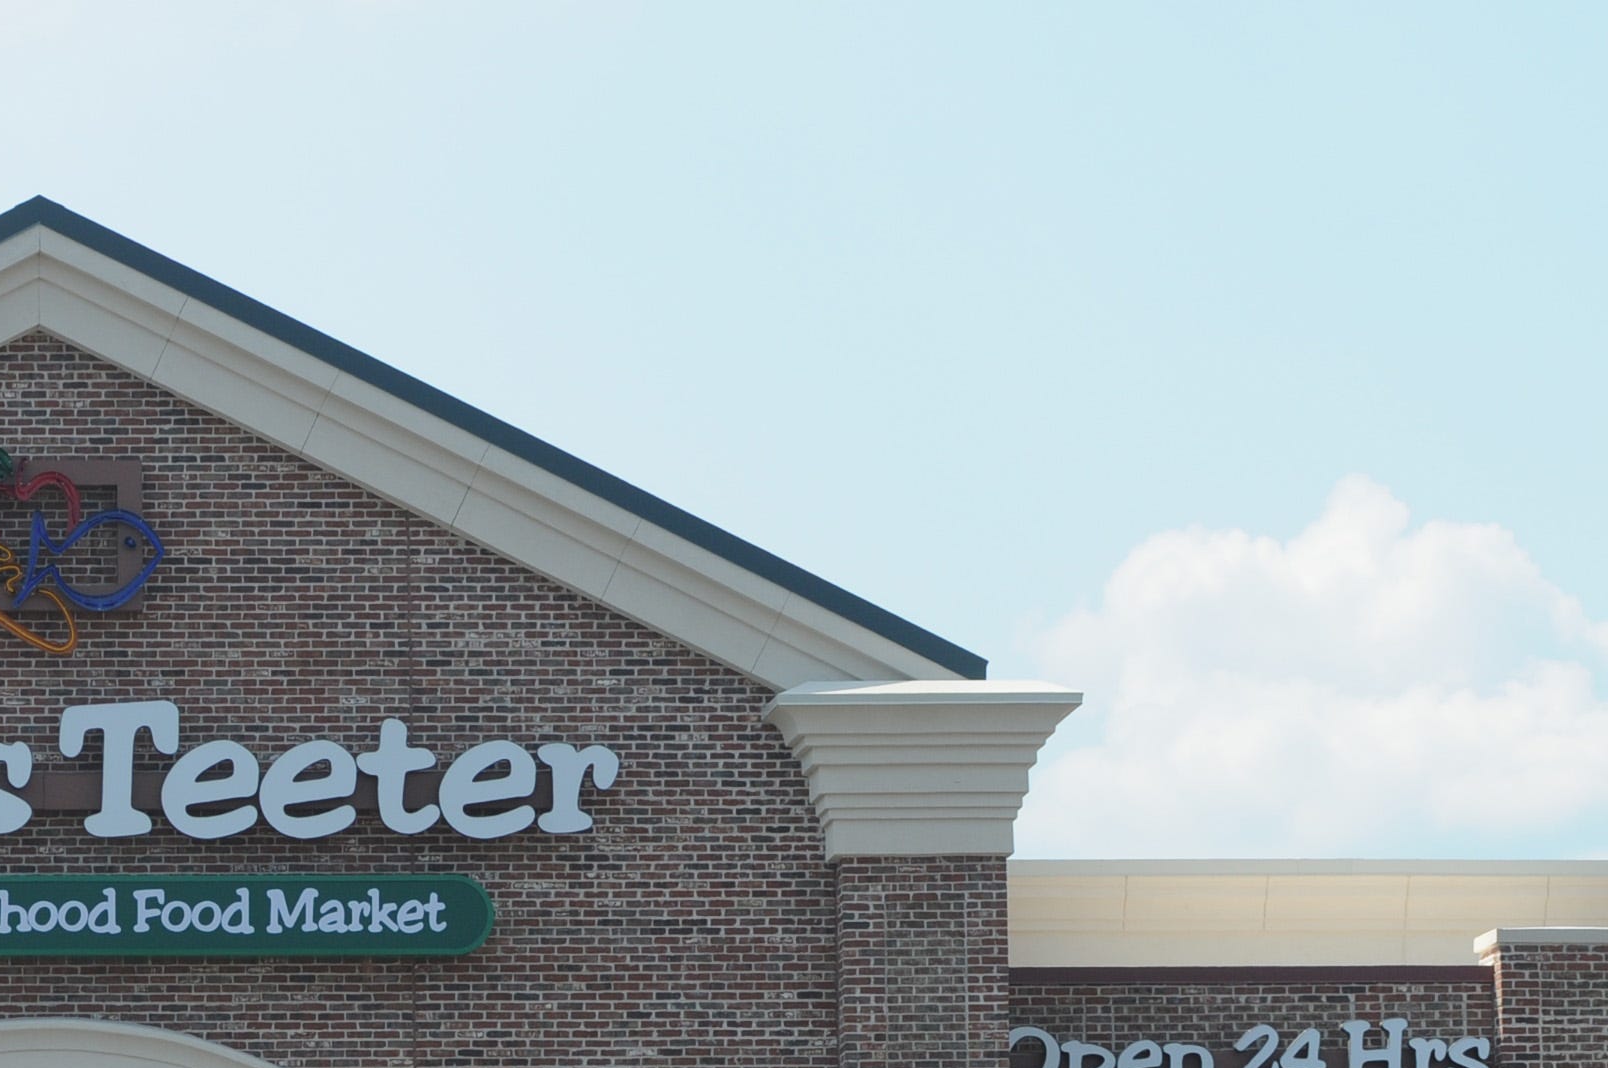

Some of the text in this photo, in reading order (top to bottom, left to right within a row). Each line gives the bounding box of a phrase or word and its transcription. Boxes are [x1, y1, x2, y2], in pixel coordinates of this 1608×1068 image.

[59, 700, 619, 840] Teeter
[131, 888, 255, 936] Food
[267, 889, 447, 937] Market
